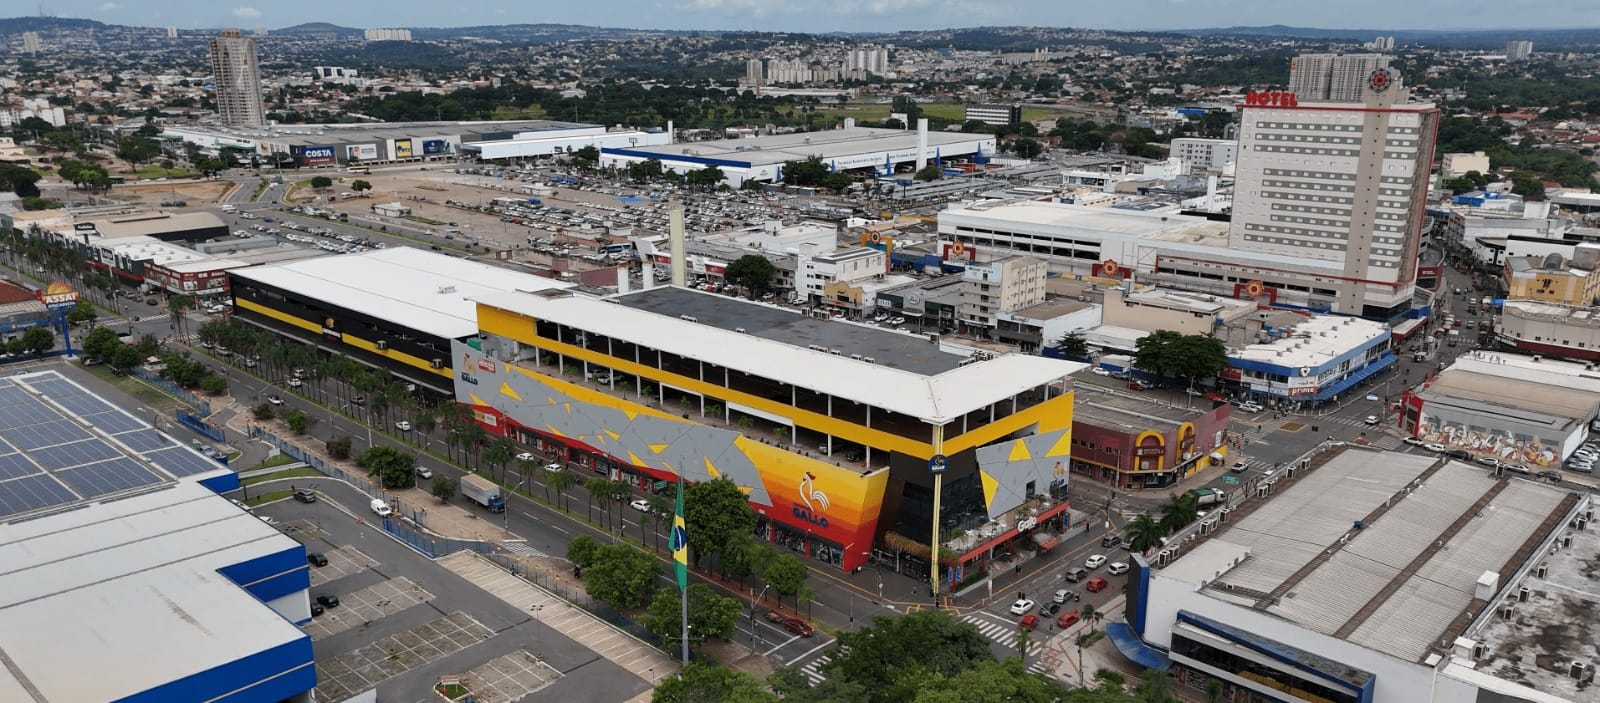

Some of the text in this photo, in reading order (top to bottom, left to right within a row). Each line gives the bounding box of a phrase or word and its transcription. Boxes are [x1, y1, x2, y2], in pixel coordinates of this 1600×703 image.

[1245, 91, 1298, 106] HOTEL
[305, 149, 332, 158] COSTA
[1291, 387, 1314, 396] prime
[792, 507, 828, 528] GALLO
[1017, 516, 1037, 533] Gallo
